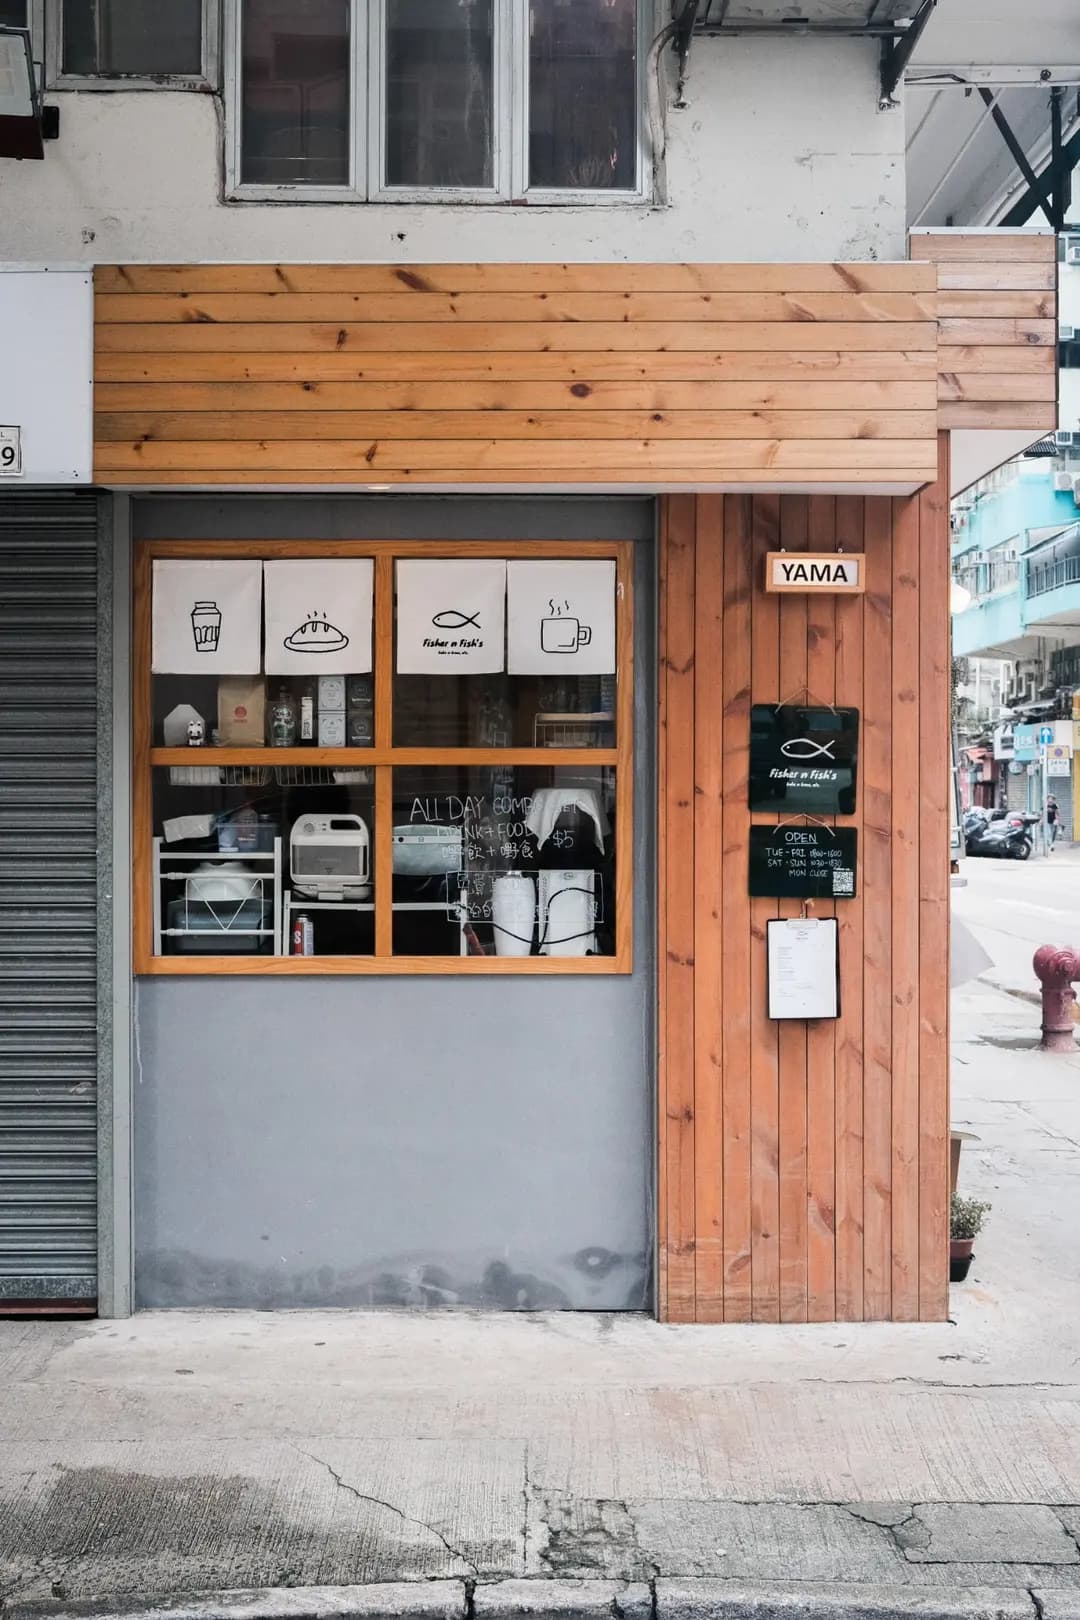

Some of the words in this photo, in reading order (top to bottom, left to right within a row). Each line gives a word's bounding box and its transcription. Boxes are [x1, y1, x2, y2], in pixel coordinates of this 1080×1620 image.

[2, 446, 15, 467] 9
[781, 563, 849, 583] YAMA
[422, 638, 448, 648] Fisher
[459, 638, 484, 648] Fish's
[769, 768, 799, 779] Fisher
[800, 771, 808, 779] n
[810, 769, 838, 780] Fish's
[410, 797, 445, 822] ALL
[446, 795, 485, 820] DAY
[497, 821, 534, 838] FOOD
[784, 831, 817, 844] OPEN
[765, 848, 784, 857] TUE
[791, 848, 806, 858] FRI
[767, 859, 783, 868] SAT
[790, 859, 806, 867] SUN
[788, 869, 807, 877] MON
